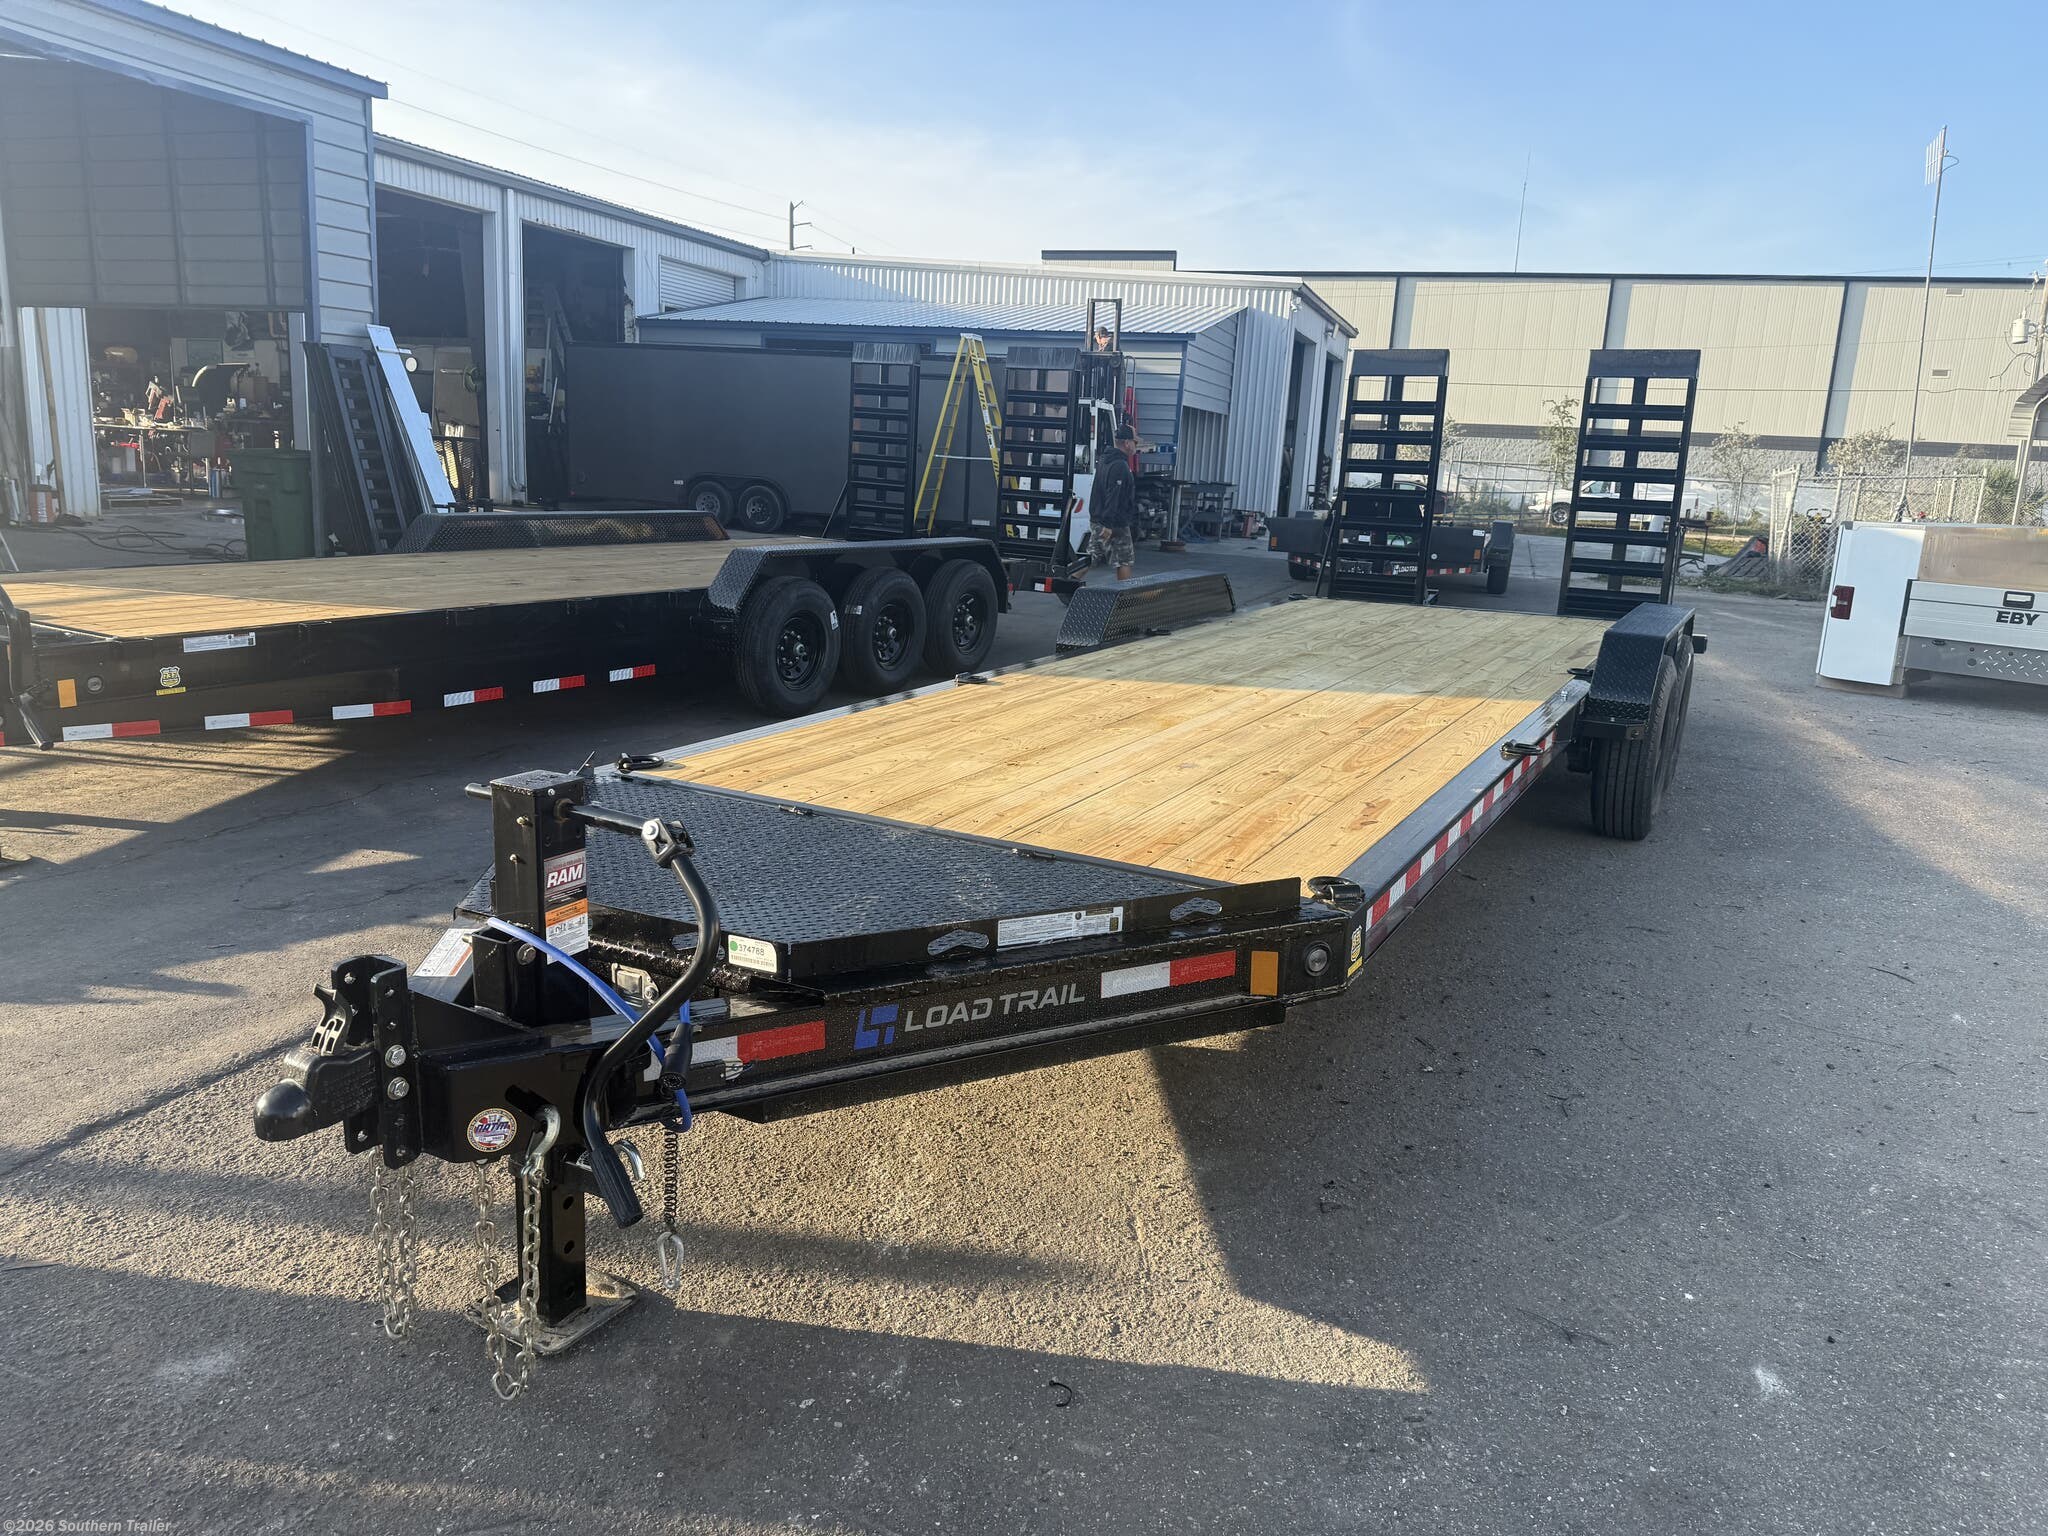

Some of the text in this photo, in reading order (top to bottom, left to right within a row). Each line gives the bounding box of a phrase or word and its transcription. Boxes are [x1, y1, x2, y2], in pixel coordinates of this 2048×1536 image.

[1996, 610, 2040, 626] EBY
[546, 863, 583, 888] RAM
[904, 997, 993, 1032] LOAD
[998, 983, 1085, 1015] TRAIL
